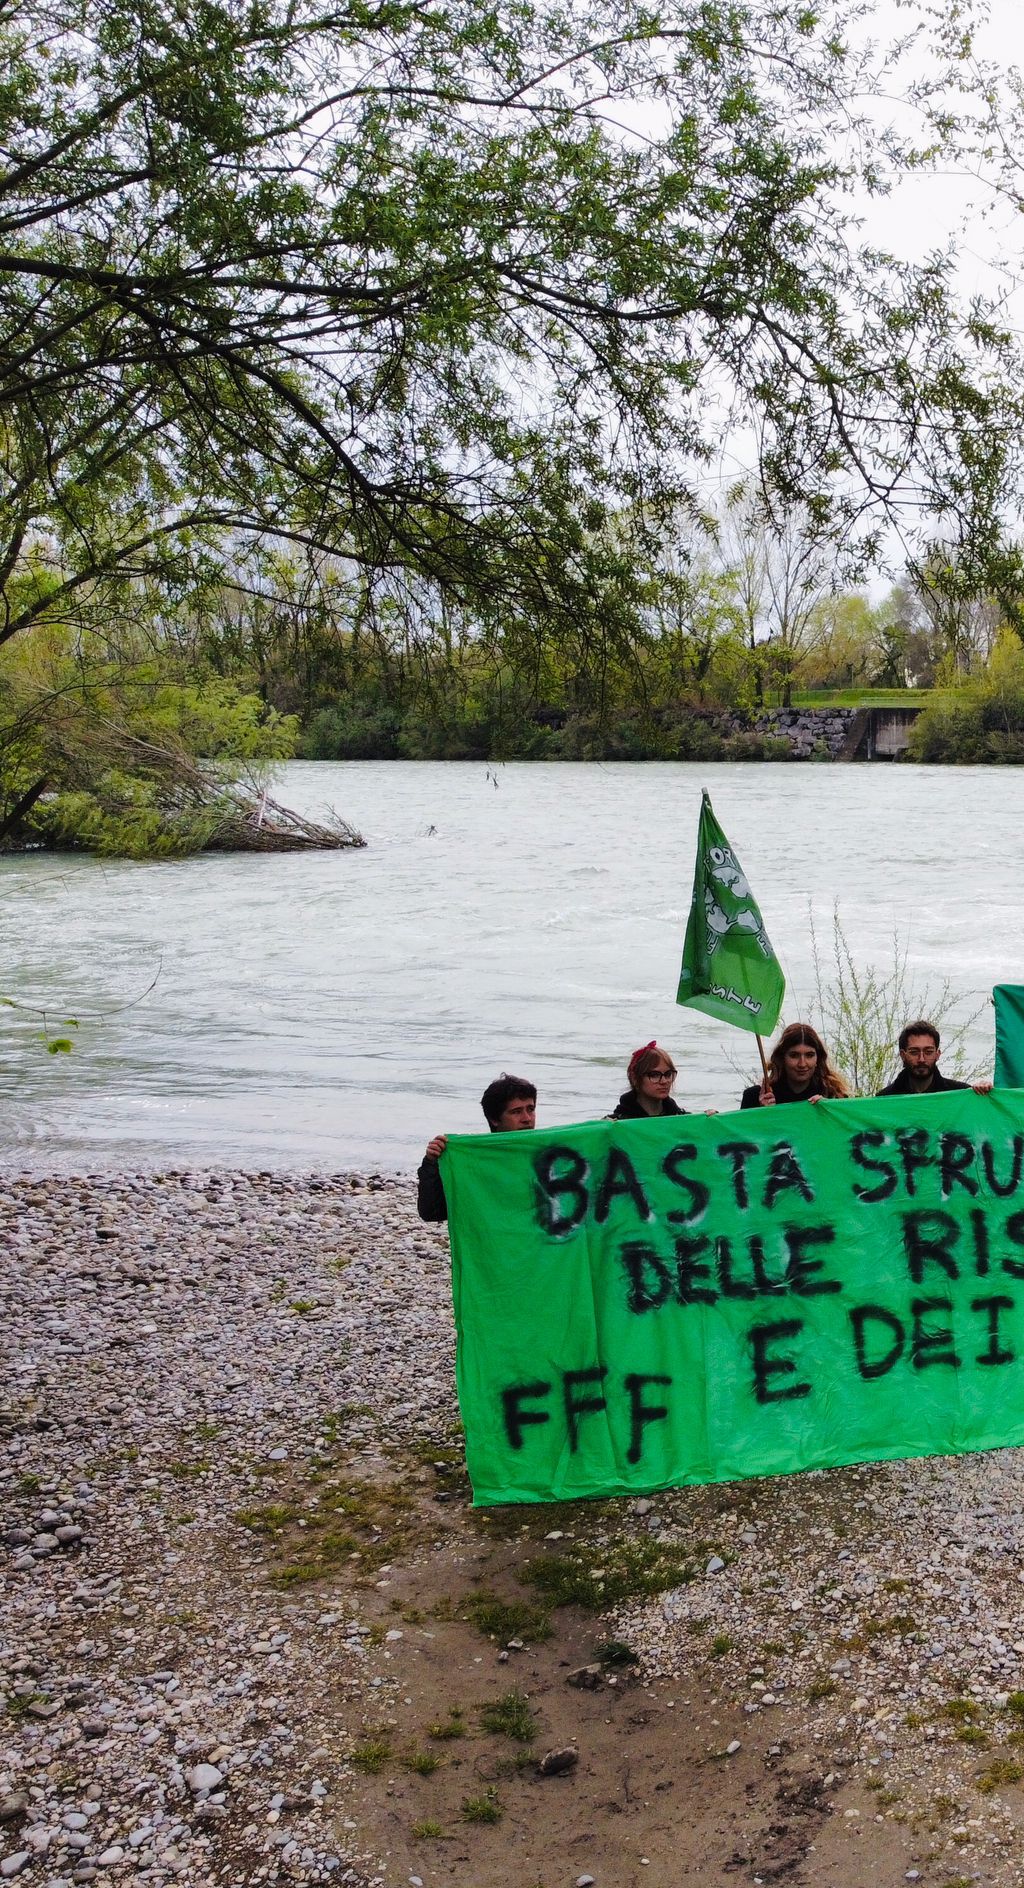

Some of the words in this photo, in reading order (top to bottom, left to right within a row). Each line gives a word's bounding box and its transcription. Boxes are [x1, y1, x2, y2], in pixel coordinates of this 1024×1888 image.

[533, 1140, 816, 1240] BASTA
[619, 1224, 843, 1315] DELLE
[747, 1319, 812, 1405] E
[849, 1296, 1016, 1380] DEI
[500, 1362, 673, 1465] FFF
